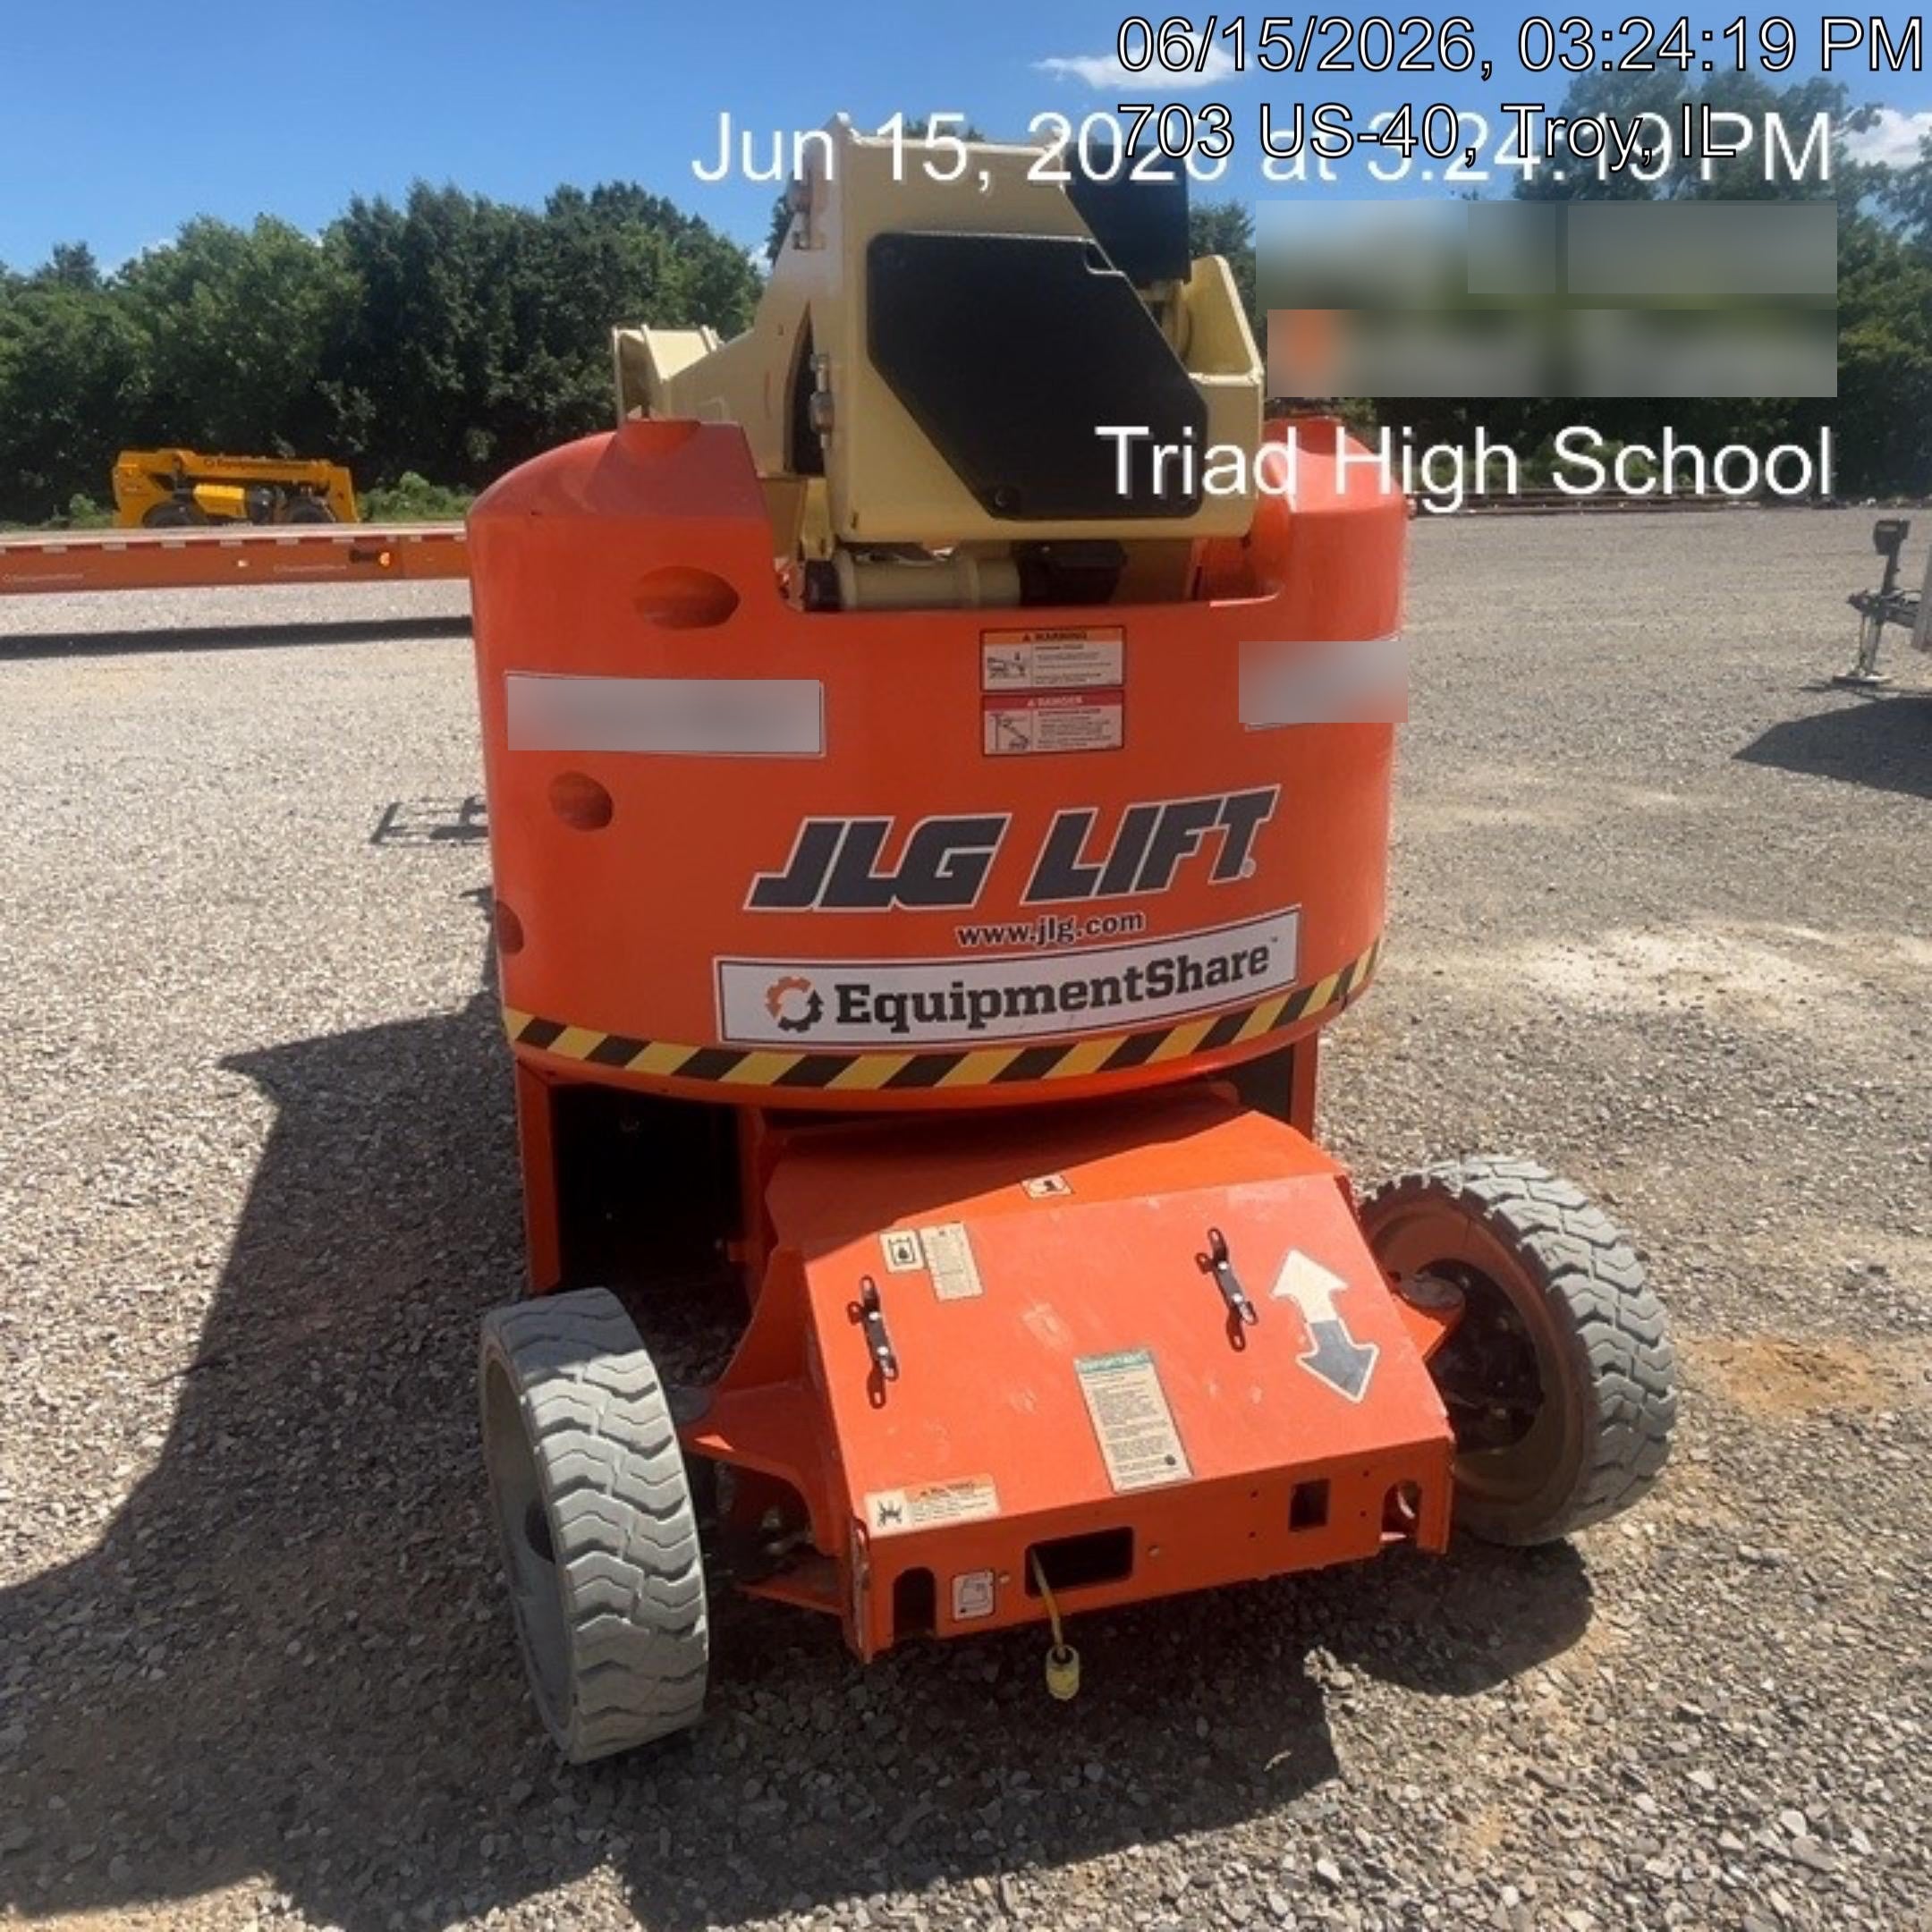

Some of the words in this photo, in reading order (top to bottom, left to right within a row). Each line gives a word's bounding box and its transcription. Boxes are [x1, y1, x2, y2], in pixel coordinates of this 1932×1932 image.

[743, 814, 1012, 911] JLG
[1020, 784, 1281, 905] LIFT
[954, 910, 1146, 948] www.jlg.com
[835, 944, 1269, 1033] EquipmentShare
